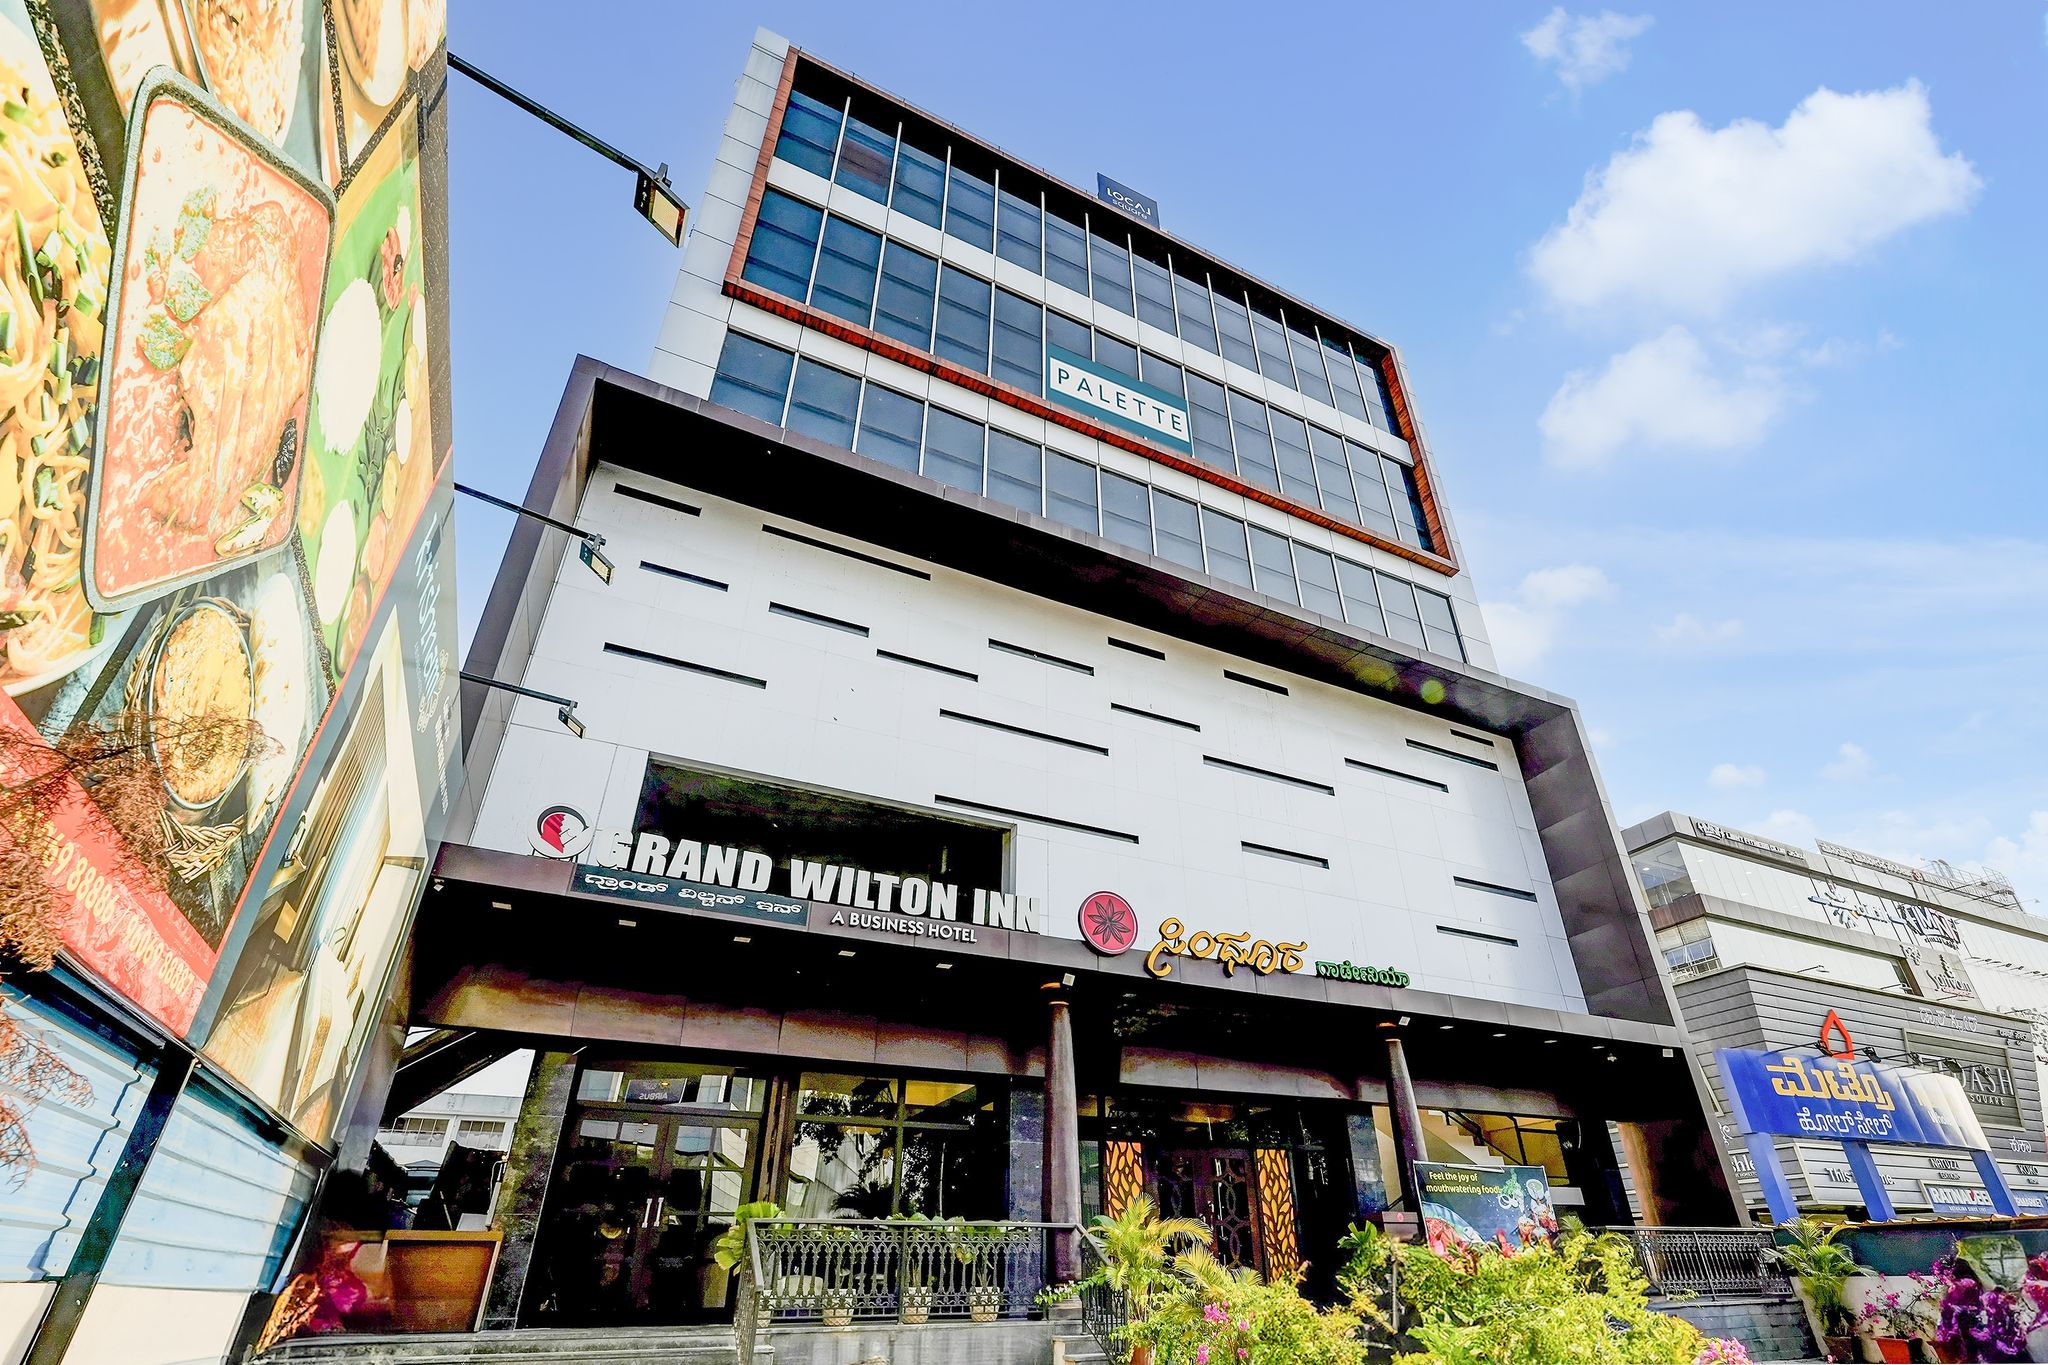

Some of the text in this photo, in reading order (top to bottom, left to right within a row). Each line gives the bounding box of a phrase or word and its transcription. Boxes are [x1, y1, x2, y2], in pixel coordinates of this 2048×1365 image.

[1112, 199, 1148, 220] square
[1058, 368, 1182, 432] PALETTE
[584, 873, 803, 914] ಗ್ರಾಂಡ್ ವಿಲ್ಟನ್ ಇನ್
[595, 829, 1041, 933] GRAND WILTON INN
[831, 911, 978, 944] A BUSINESS HOTEL
[1146, 917, 1308, 977] ಸಿಂಧೂರ
[1428, 1171, 1478, 1183] Feel the joy of
[1825, 1167, 1853, 1183] This
[1426, 1184, 1482, 1195] mouthwatering
[1928, 1187, 1993, 1206] RATNADEE
